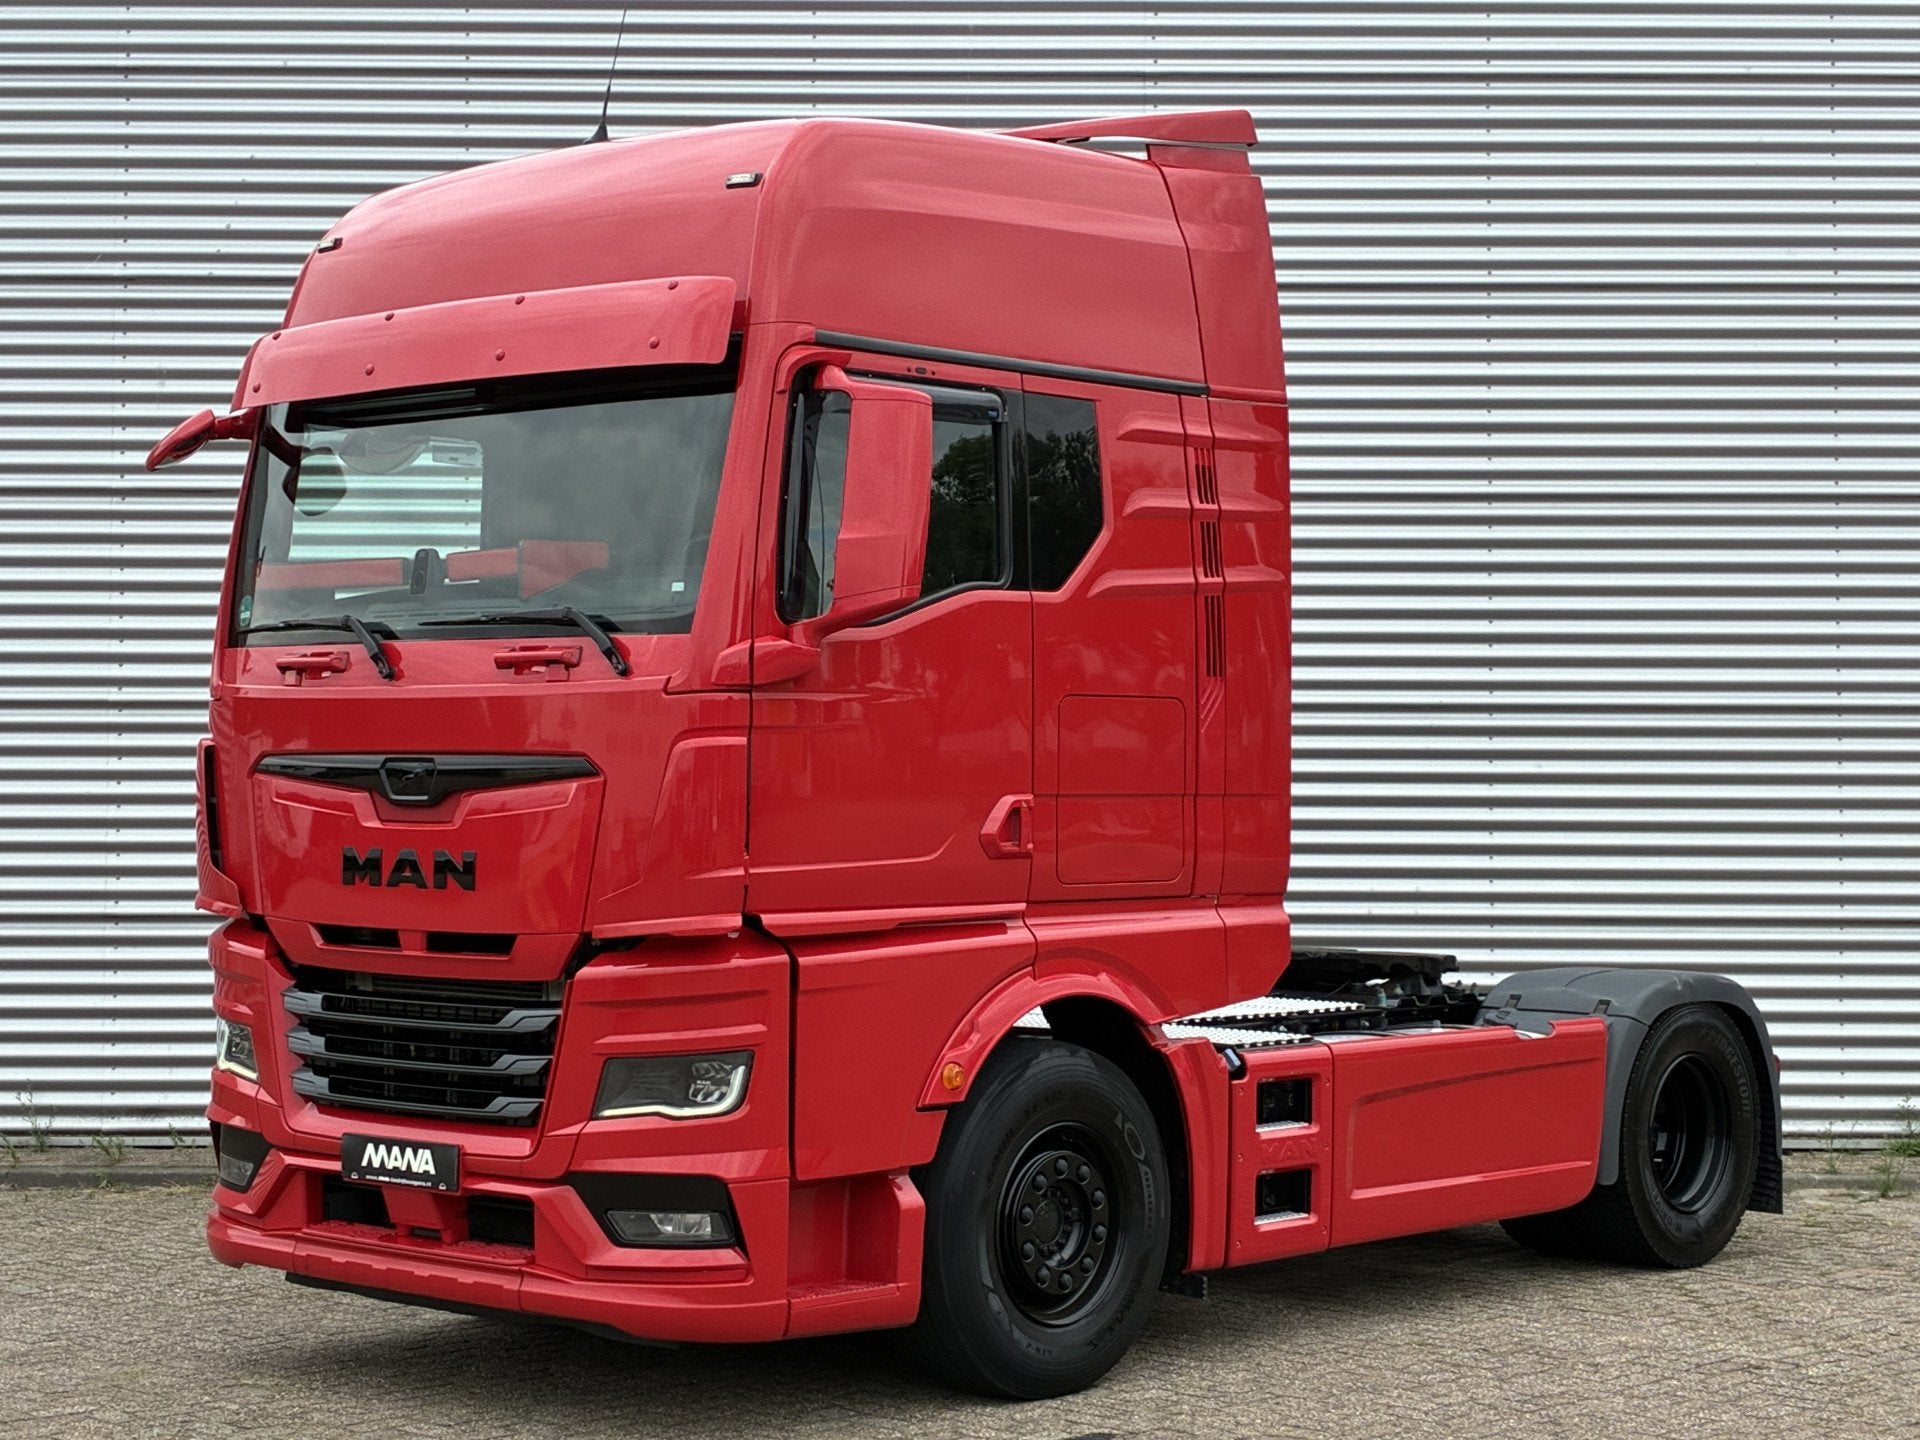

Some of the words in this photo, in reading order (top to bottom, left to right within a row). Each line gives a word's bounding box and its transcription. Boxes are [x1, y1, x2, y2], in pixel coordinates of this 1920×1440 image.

[342, 847, 476, 892] MAN
[361, 1143, 436, 1175] MANA
[1261, 1138, 1317, 1164] MAN
